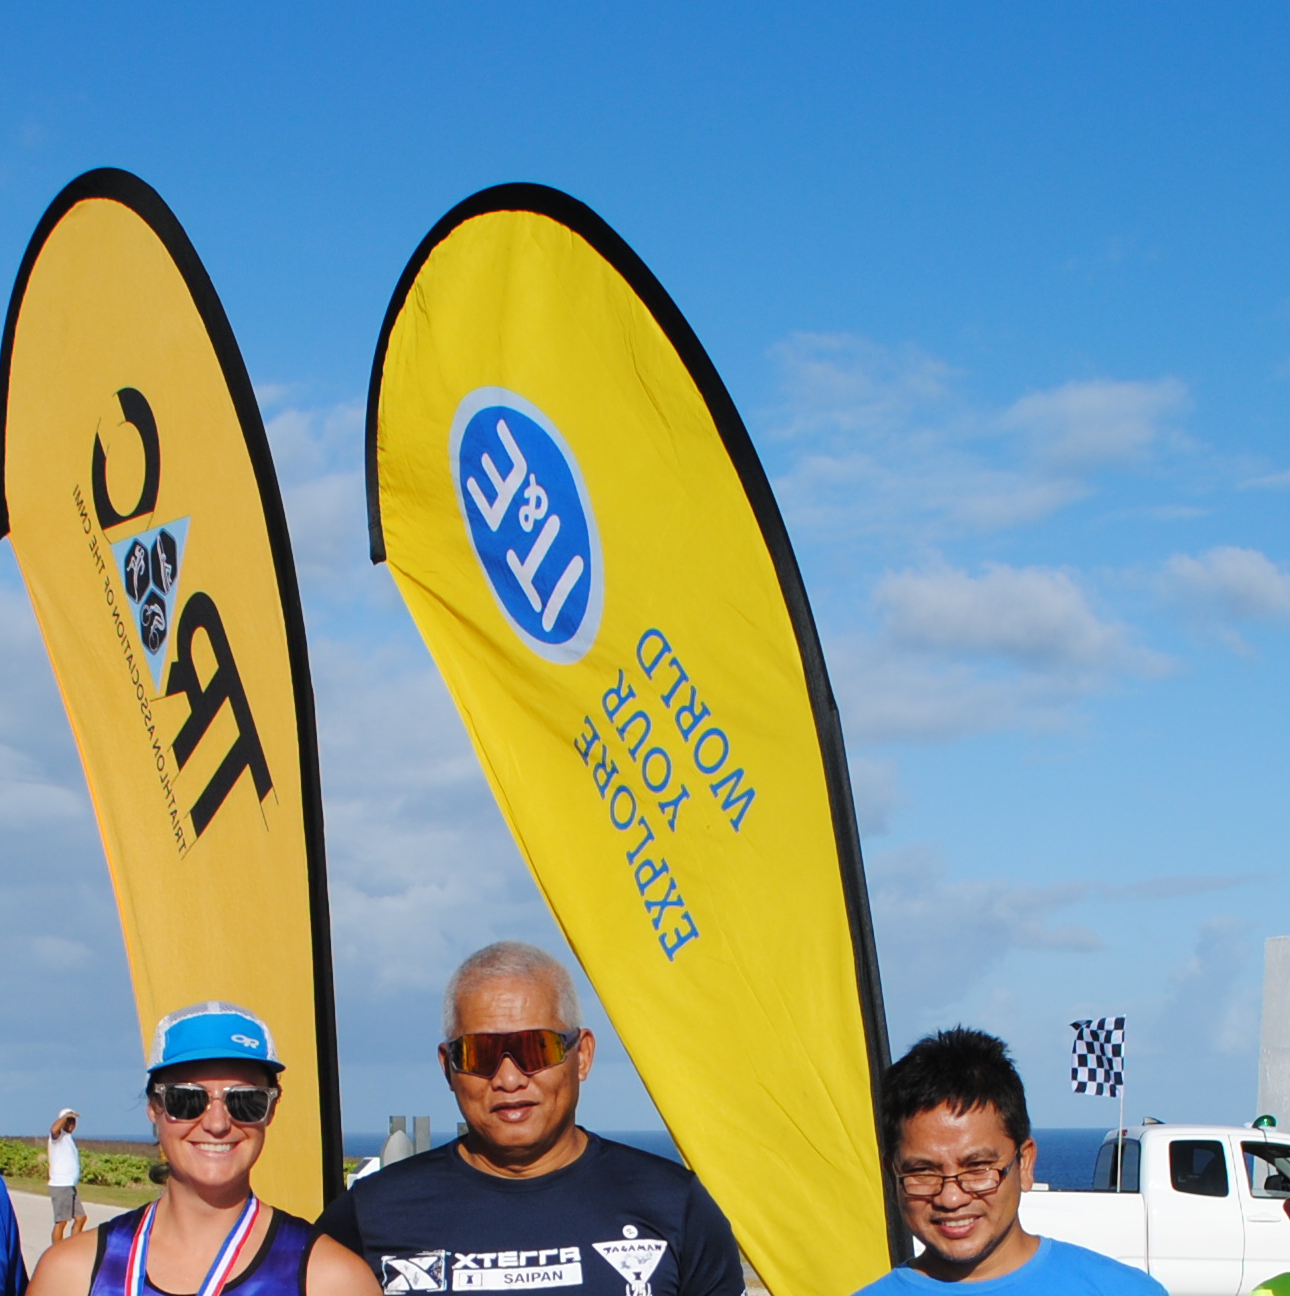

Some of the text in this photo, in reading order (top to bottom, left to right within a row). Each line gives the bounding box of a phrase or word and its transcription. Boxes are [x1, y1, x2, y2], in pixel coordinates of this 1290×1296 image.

[466, 418, 584, 633] IT&E
[601, 667, 691, 833] YOUR
[635, 627, 756, 833] WORLD
[573, 715, 699, 962] EXPLORE
[504, 1270, 564, 1285] SAIPAN
